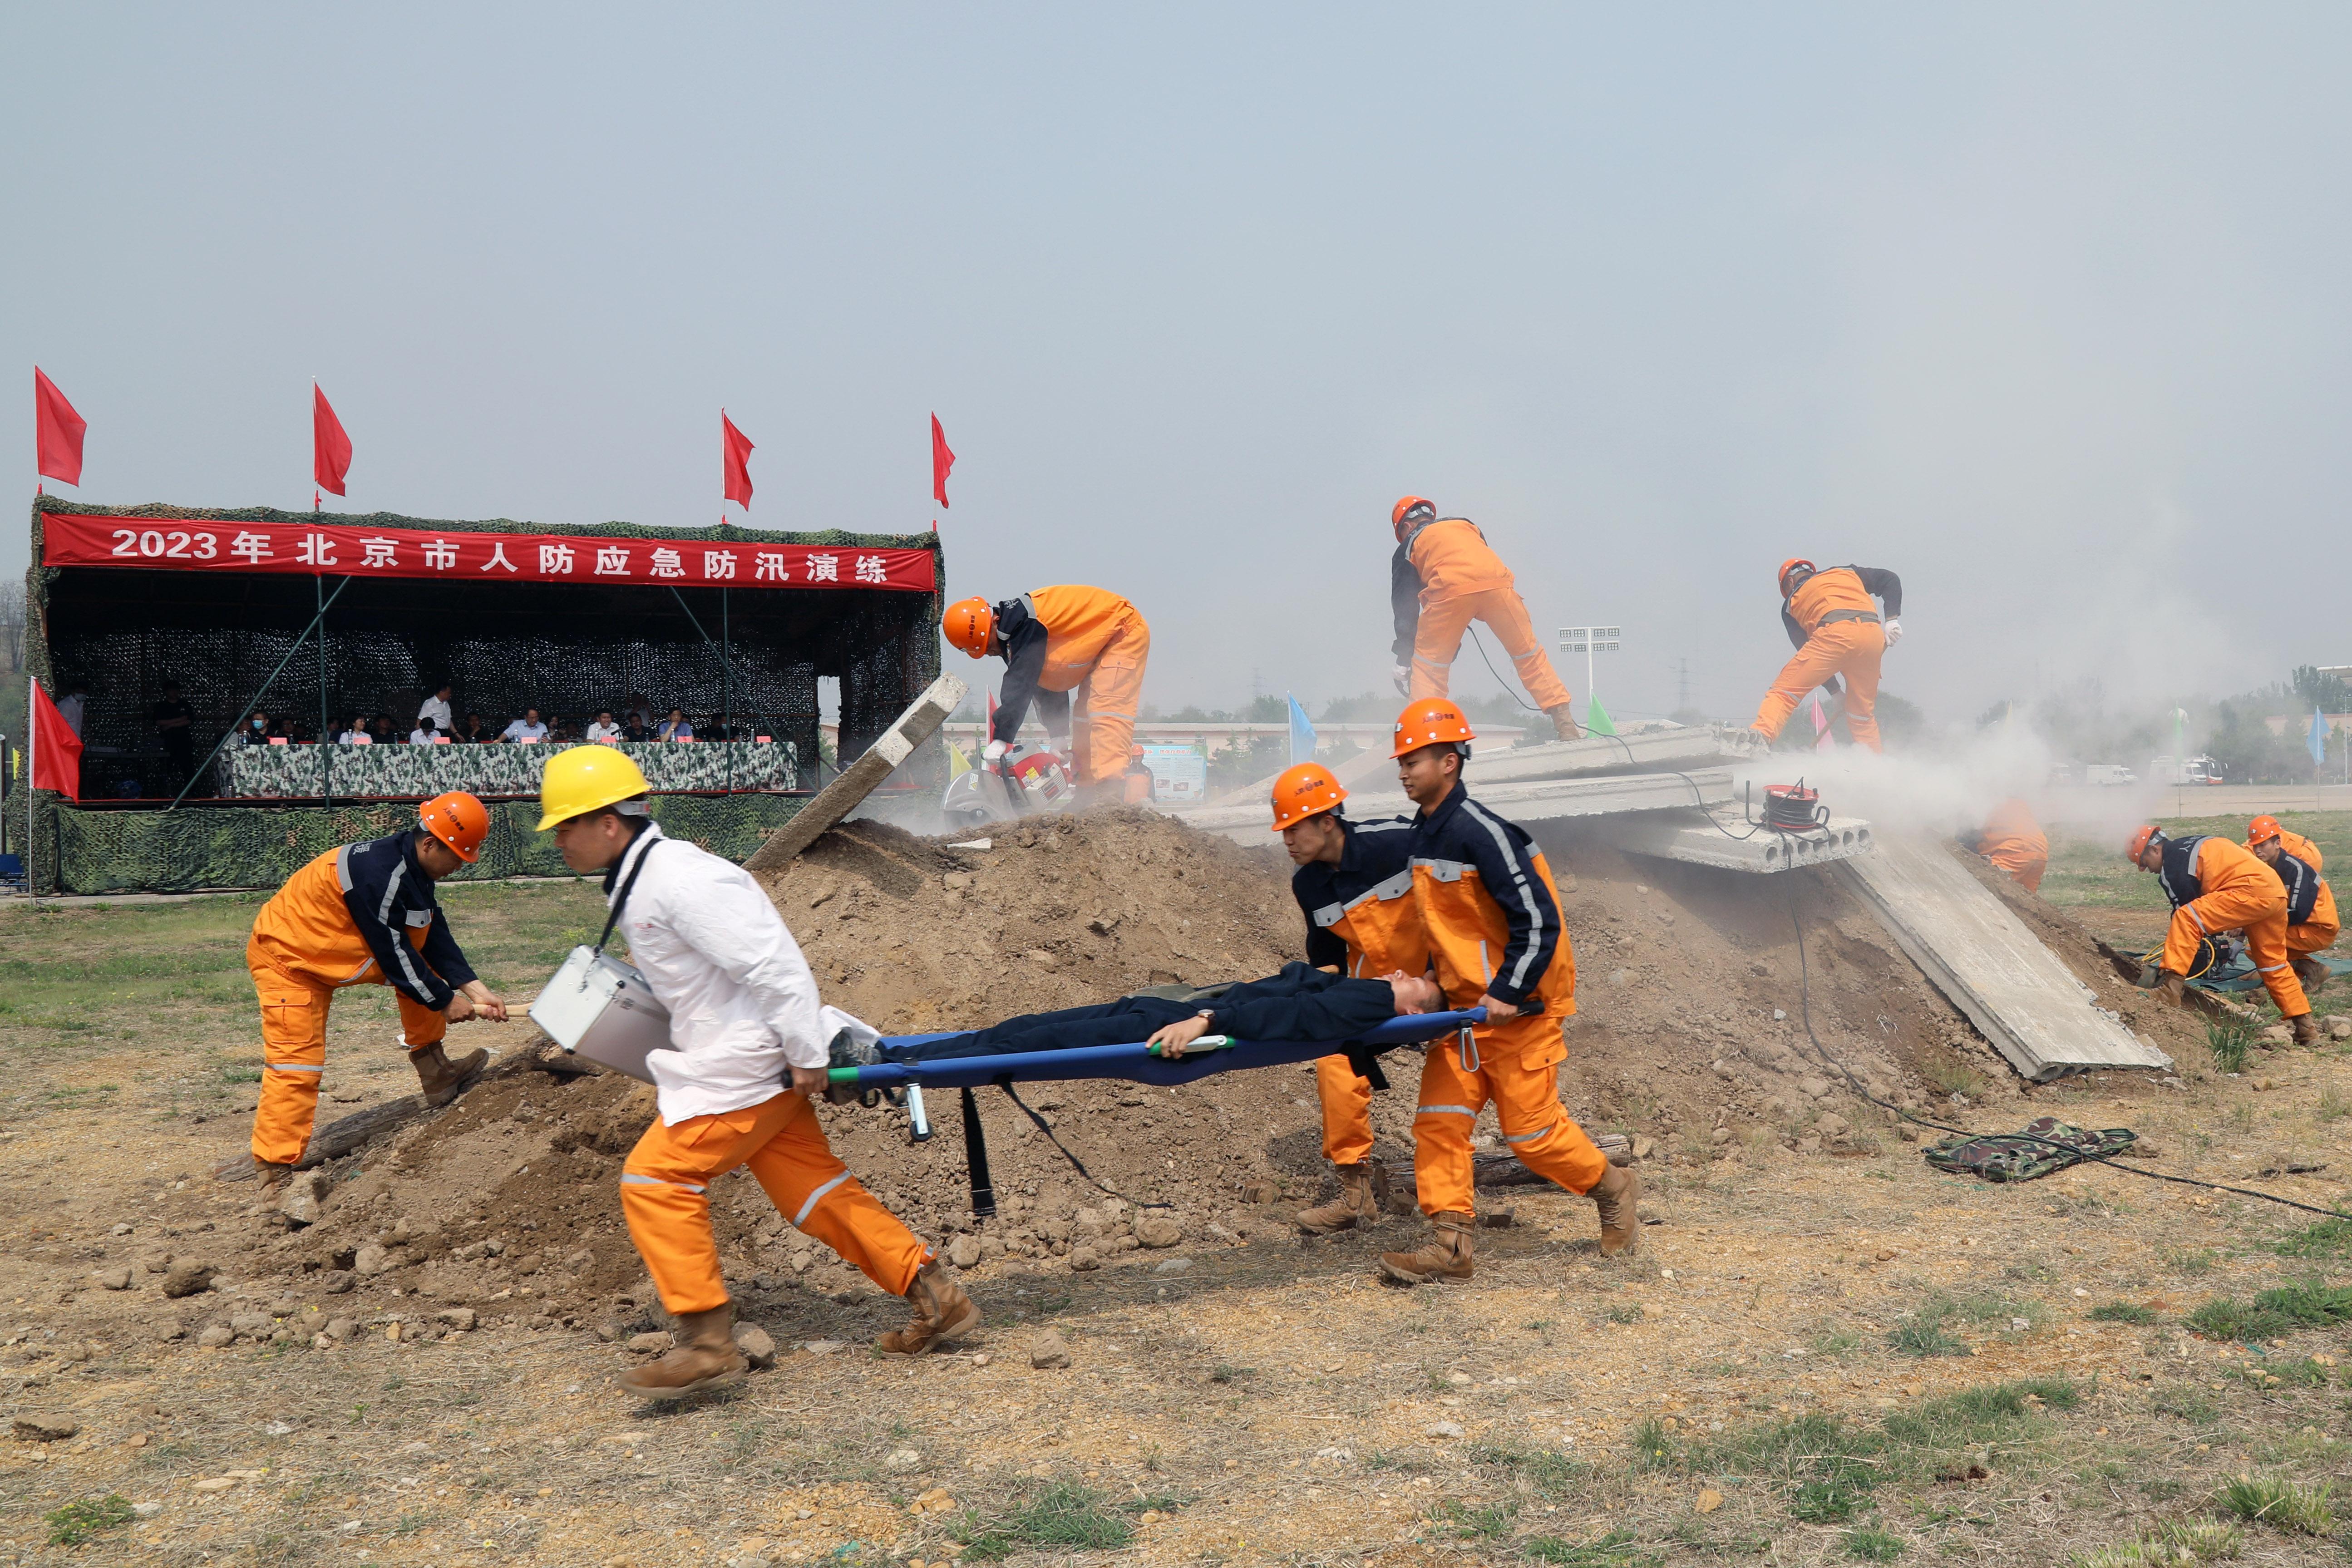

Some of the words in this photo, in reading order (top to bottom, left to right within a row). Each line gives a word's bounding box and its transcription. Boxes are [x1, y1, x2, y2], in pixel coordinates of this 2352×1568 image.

[112, 529, 888, 584] 2023年北京市人防应急防汛演练
